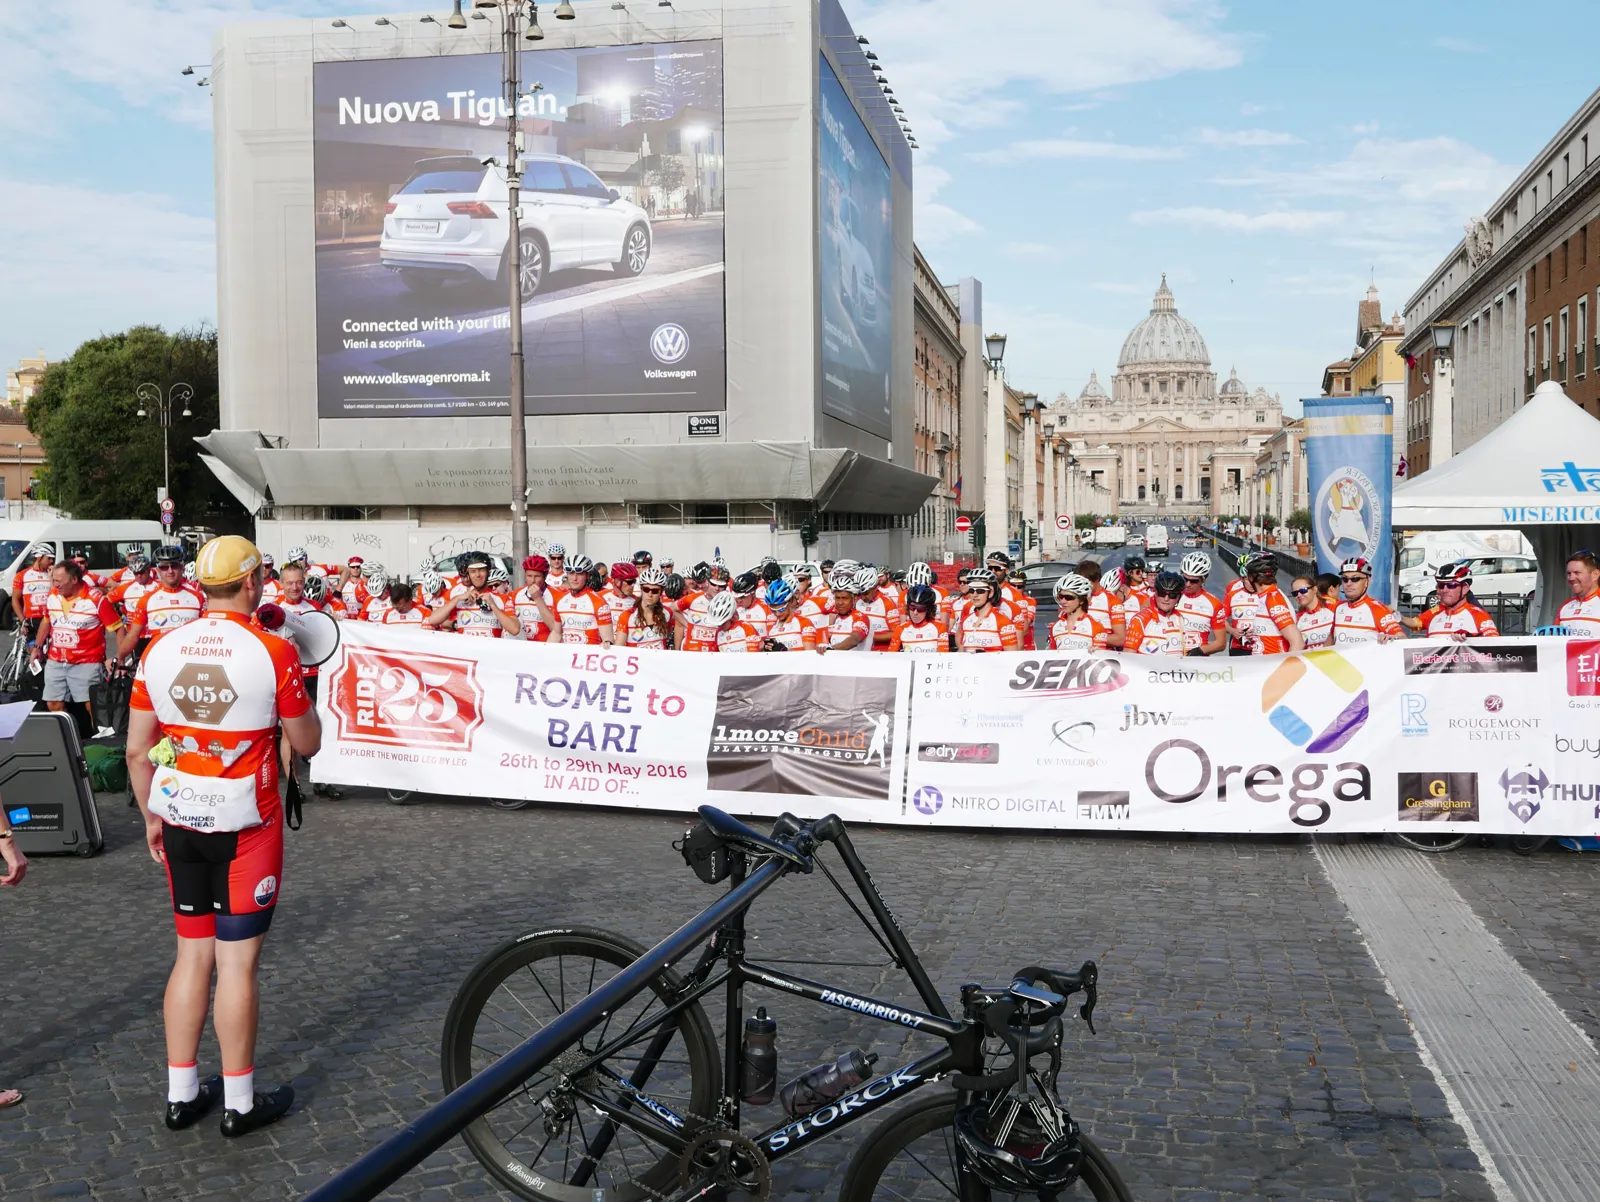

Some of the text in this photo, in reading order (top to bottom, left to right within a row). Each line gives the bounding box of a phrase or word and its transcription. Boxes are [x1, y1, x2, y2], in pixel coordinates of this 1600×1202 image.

[338, 96, 440, 125] Nuova
[342, 318, 418, 333] Connected
[421, 317, 454, 331] with
[456, 318, 486, 334] your
[343, 337, 425, 350] Vieni a scoprirla.
[343, 369, 490, 385] www.volkswagenroma.it
[644, 368, 697, 379] Volkswagen
[699, 417, 717, 425] ONE
[427, 467, 441, 476] Le
[443, 466, 527, 478] sponsorizzazi
[559, 465, 614, 475] finalizzate
[414, 480, 424, 488] ai
[426, 480, 456, 488] lavori
[459, 479, 469, 488] di
[547, 477, 558, 487] di
[561, 478, 595, 488] questo
[598, 477, 638, 488] palazzo
[195, 636, 224, 646] JOHN
[967, 635, 993, 646] Orega
[1063, 637, 1089, 649] Orega
[180, 645, 233, 658] READMAN
[1412, 651, 1460, 665] Herbert
[1495, 654, 1503, 662] &
[1505, 653, 1523, 662] Son
[570, 652, 640, 675] LEG 5
[926, 662, 954, 671] THE
[924, 676, 980, 685] OFFICE
[1009, 658, 1122, 691] SEKO
[1148, 666, 1236, 684] activbod
[187, 685, 217, 704] 05
[356, 663, 379, 728] RIDE
[377, 665, 459, 724] 25
[514, 672, 686, 717] ROME to
[924, 690, 974, 699] GROUP
[1568, 700, 1591, 709] Good
[1119, 704, 1173, 732] jbw
[1448, 718, 1542, 729] ROUGEMONT
[546, 718, 642, 753] BARI
[713, 725, 867, 749] 1moreChild
[1468, 730, 1521, 741] ESTATES
[339, 747, 468, 767] EXPLORE THE WORLD LEG BY LEG
[1055, 758, 1086, 767] TAYLOR
[499, 752, 688, 779] 26th to 29th May 2016
[543, 775, 640, 795] IN AID OF...
[1145, 738, 1373, 827] Orega
[180, 787, 226, 807] Orega
[1405, 798, 1471, 811] Gressingham
[1006, 798, 1067, 813] DIGITAL
[1077, 804, 1130, 820] EMW
[819, 989, 924, 1029] FASCENARIO 0.7
[768, 1063, 922, 1152] STORCK
[506, 1161, 546, 1191] Lightweight
